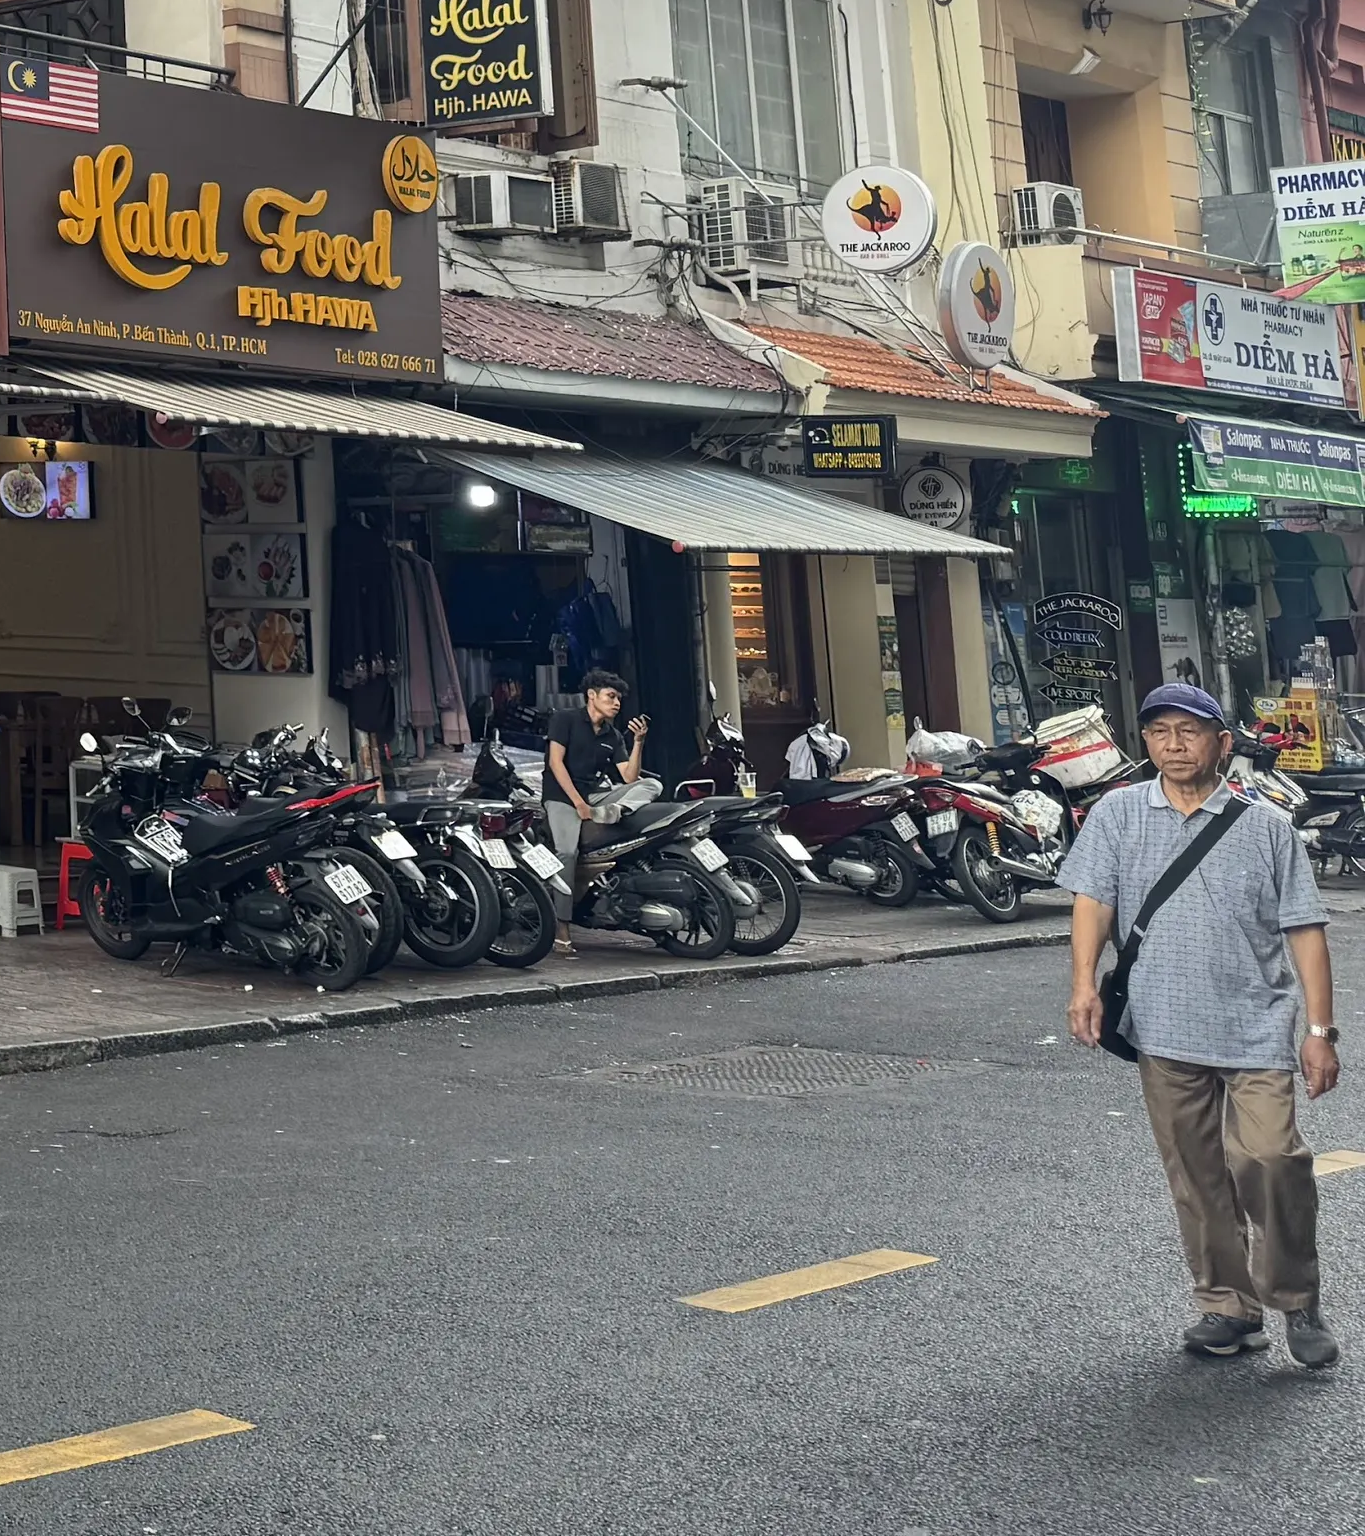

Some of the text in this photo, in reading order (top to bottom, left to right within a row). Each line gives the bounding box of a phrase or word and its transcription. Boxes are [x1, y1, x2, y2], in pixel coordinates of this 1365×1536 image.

[430, 44, 533, 92] Food
[392, 146, 435, 183] حلال
[58, 143, 402, 290] Halal Food
[840, 242, 910, 253] THE JACKAROO
[1240, 297, 1258, 314] NHÀ
[1260, 301, 1288, 318] THUỐC
[1302, 310, 1325, 326] NHÂN
[967, 332, 1008, 347] THE JACKAROO
[1264, 320, 1304, 338] PHARMACY
[335, 347, 437, 374] Tel: 028 627 666 71
[1234, 334, 1339, 382] DIỄM HÀ
[832, 423, 881, 447] SELAMAT TOUR
[1037, 598, 1119, 624] THE JACKAROO
[1044, 629, 1096, 643] COLD BEER
[1074, 667, 1107, 678] GARDEN
[1047, 687, 1092, 701] LIVE SPORT
